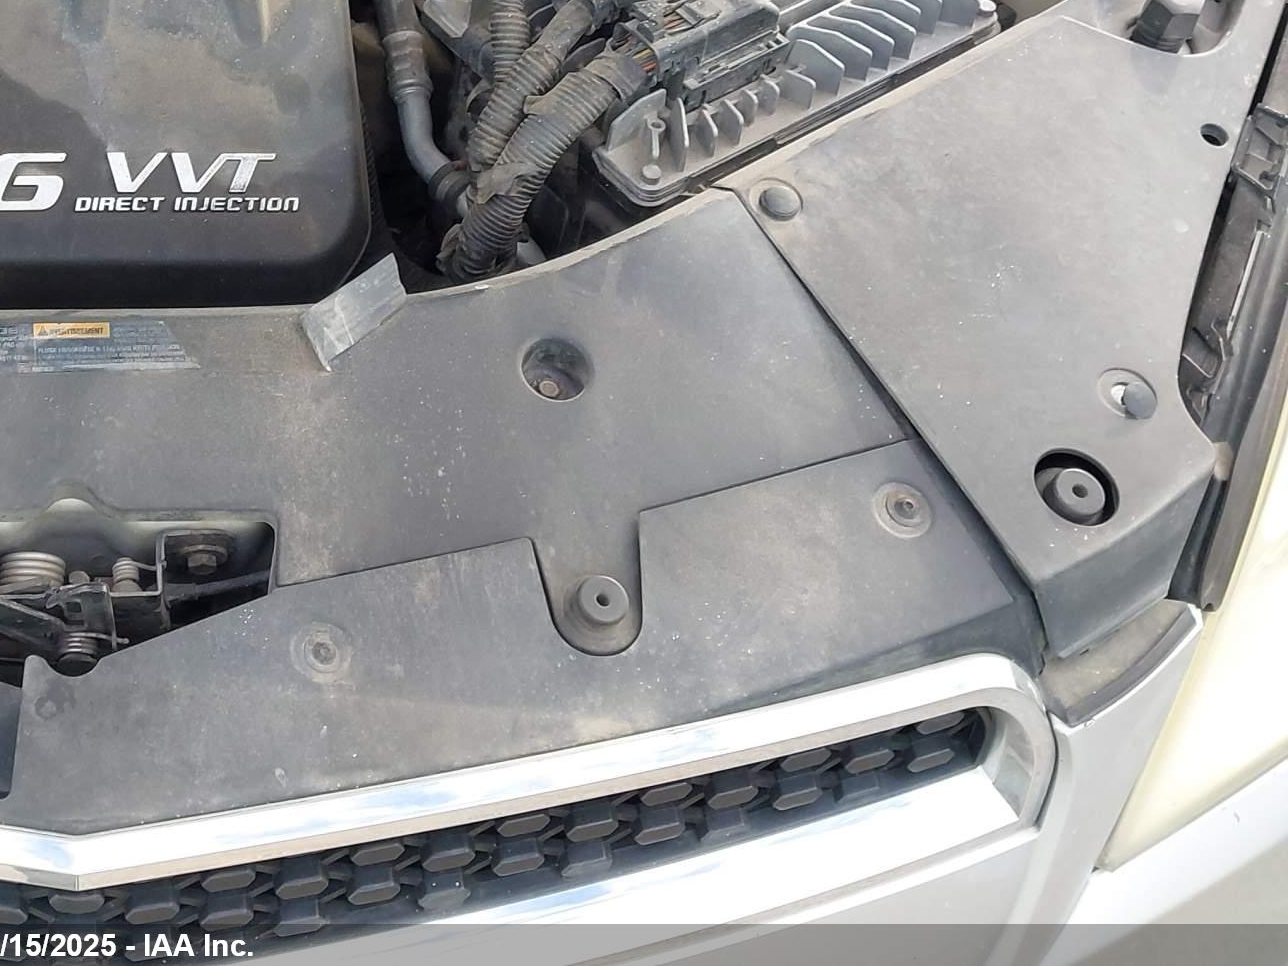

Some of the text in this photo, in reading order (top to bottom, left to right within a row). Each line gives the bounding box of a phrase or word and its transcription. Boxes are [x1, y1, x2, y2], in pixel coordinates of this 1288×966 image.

[107, 152, 277, 193] VVT
[74, 197, 300, 212] DIRECT INJECTION
